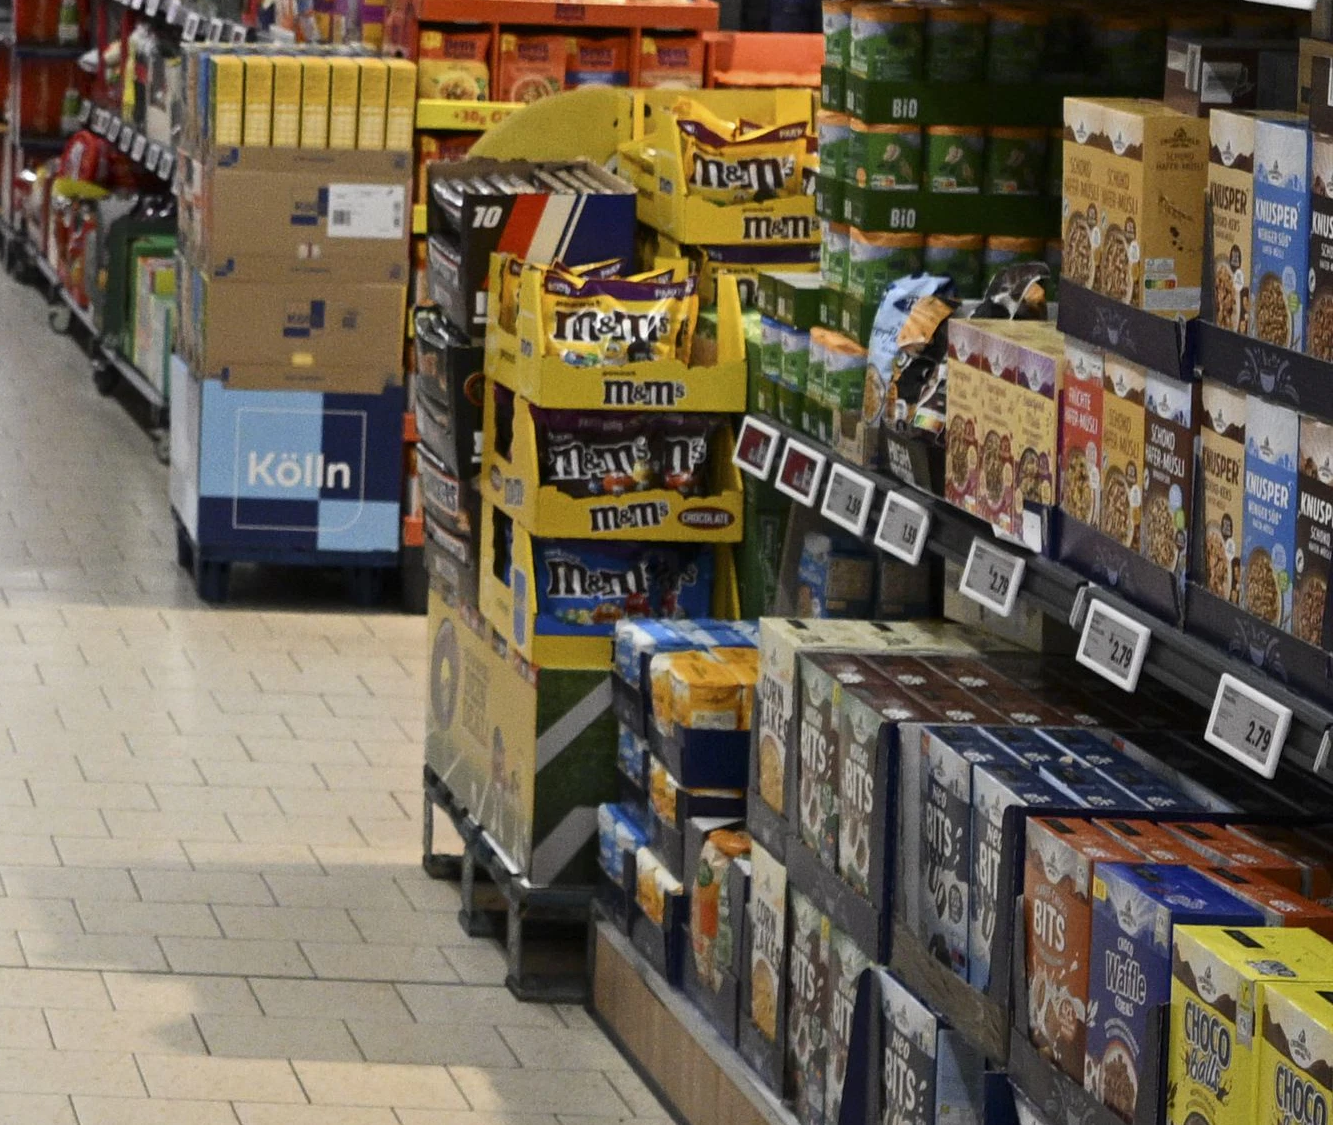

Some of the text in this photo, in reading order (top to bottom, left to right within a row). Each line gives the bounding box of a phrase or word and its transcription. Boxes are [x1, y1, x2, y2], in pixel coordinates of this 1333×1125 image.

[473, 206, 503, 228] 10
[1255, 198, 1299, 231] KNUSPER
[1150, 424, 1176, 452] SCHOKO
[247, 450, 352, 490] Kölln
[1246, 470, 1290, 510] KNUSPER
[1300, 491, 1333, 525] KNUSP
[1111, 644, 1134, 669] 2.79
[800, 722, 828, 772] BITS
[1244, 720, 1272, 752] 2.79
[844, 759, 874, 814] BITS
[925, 801, 953, 859] BITS
[979, 841, 1002, 890] BIT
[1032, 899, 1066, 953] BITS
[791, 951, 817, 1005] BITS
[1105, 949, 1147, 1006] Waffle
[834, 989, 854, 1042] BIT
[1184, 998, 1231, 1072] CHOCO
[884, 1050, 917, 1115] BITS
[1187, 1047, 1223, 1094] balls
[1274, 1064, 1328, 1125] CHOCO
